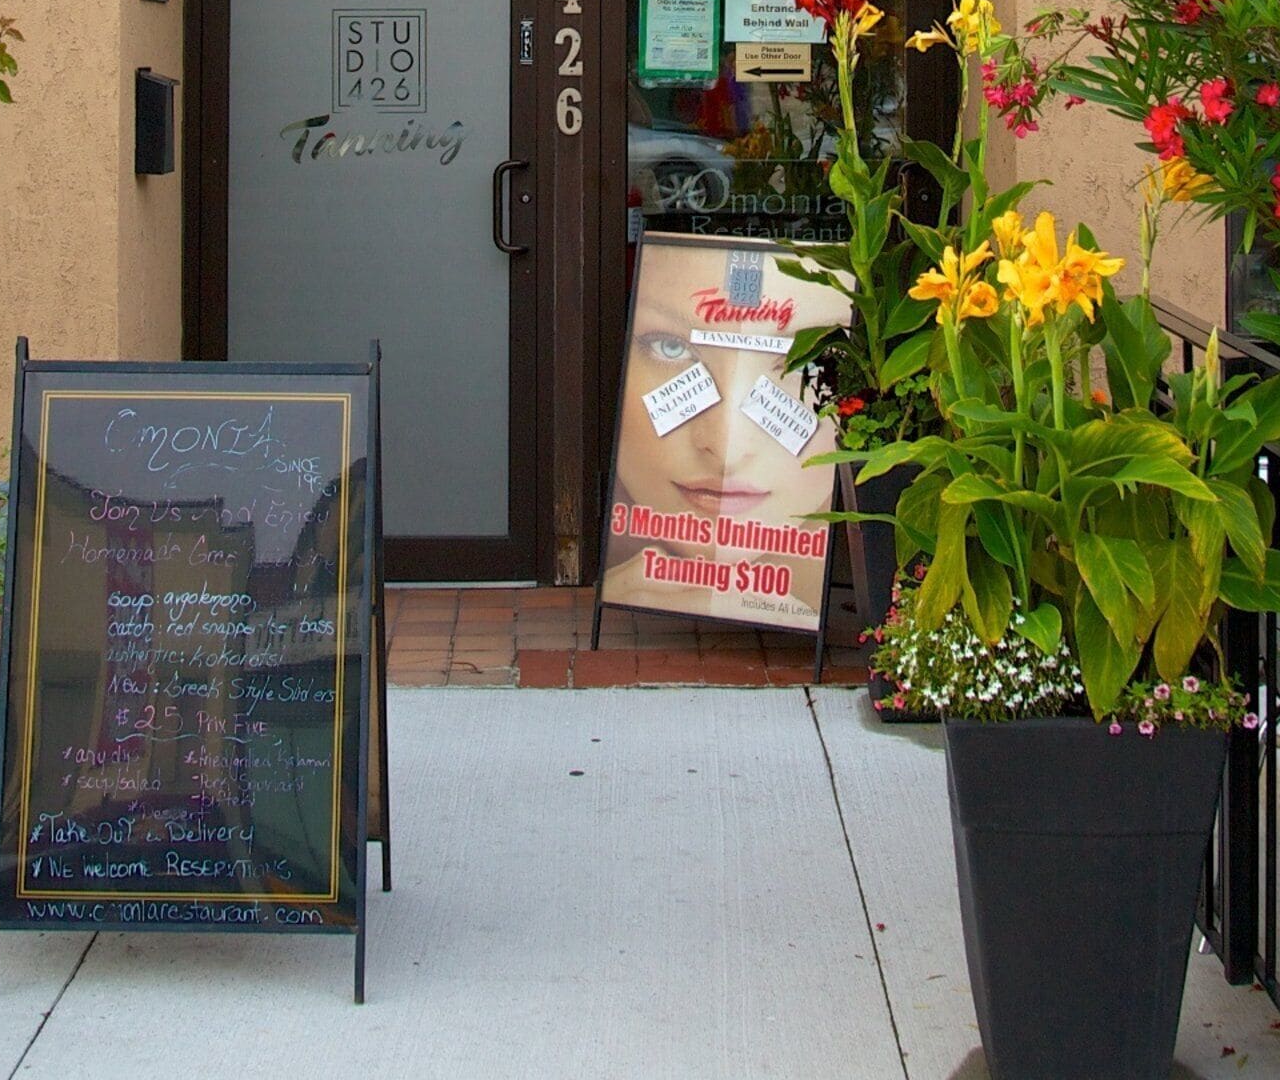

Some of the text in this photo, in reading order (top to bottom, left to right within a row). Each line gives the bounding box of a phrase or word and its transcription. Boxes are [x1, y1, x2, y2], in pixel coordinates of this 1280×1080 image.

[742, 18, 810, 29] Behind Wall
[751, 5, 802, 14] Entrance
[347, 20, 411, 45] STU
[346, 48, 415, 73] DIO
[744, 52, 802, 61] Use Other Door
[760, 46, 785, 54] Please
[347, 76, 411, 102] 426
[279, 114, 469, 166] Tanning
[686, 167, 847, 214] Omonia
[694, 295, 794, 331] Tanning
[701, 331, 785, 350] TANNING SALE
[650, 376, 713, 421] UNLIMITED
[658, 368, 703, 400] MONTH
[678, 404, 698, 419] $50
[749, 388, 809, 441] UNLIMITED
[768, 383, 814, 426] MONTHS
[759, 415, 782, 438] $100
[89, 489, 141, 531] Join
[611, 503, 827, 558] 3 Months Unlimited
[643, 549, 791, 597] Tanning $100
[740, 597, 819, 617] Includes All Levels
[166, 612, 201, 636] red
[228, 675, 275, 716] Style
[277, 676, 336, 703] Sliders
[39, 811, 92, 844] Take
[164, 818, 256, 855] Delivery
